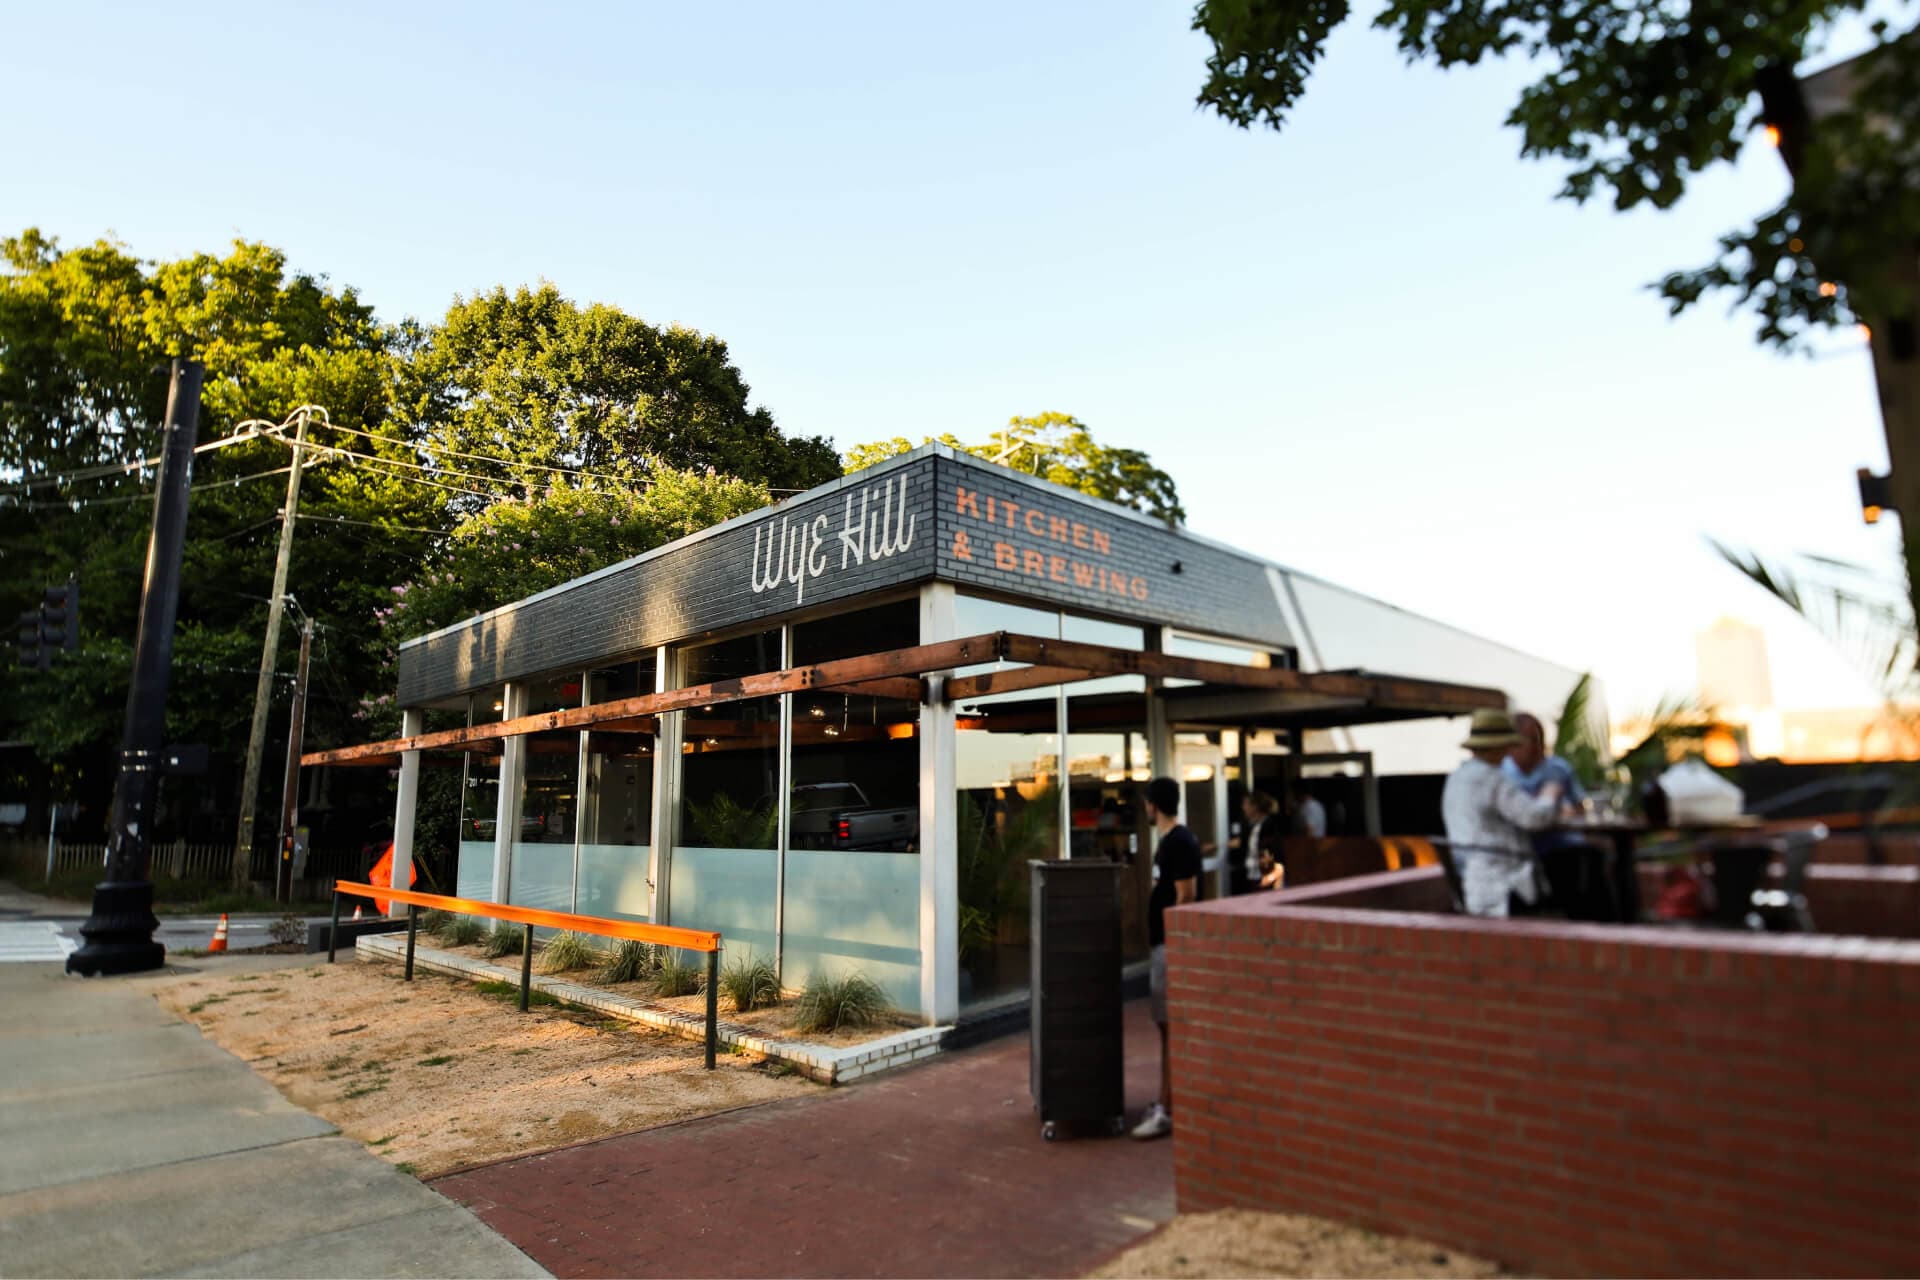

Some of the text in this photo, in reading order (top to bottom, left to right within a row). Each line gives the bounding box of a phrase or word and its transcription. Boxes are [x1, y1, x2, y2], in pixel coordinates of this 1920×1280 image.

[839, 472, 915, 570] Hill
[956, 486, 1110, 555] KITCHEN
[952, 531, 1148, 600] & BREWING
